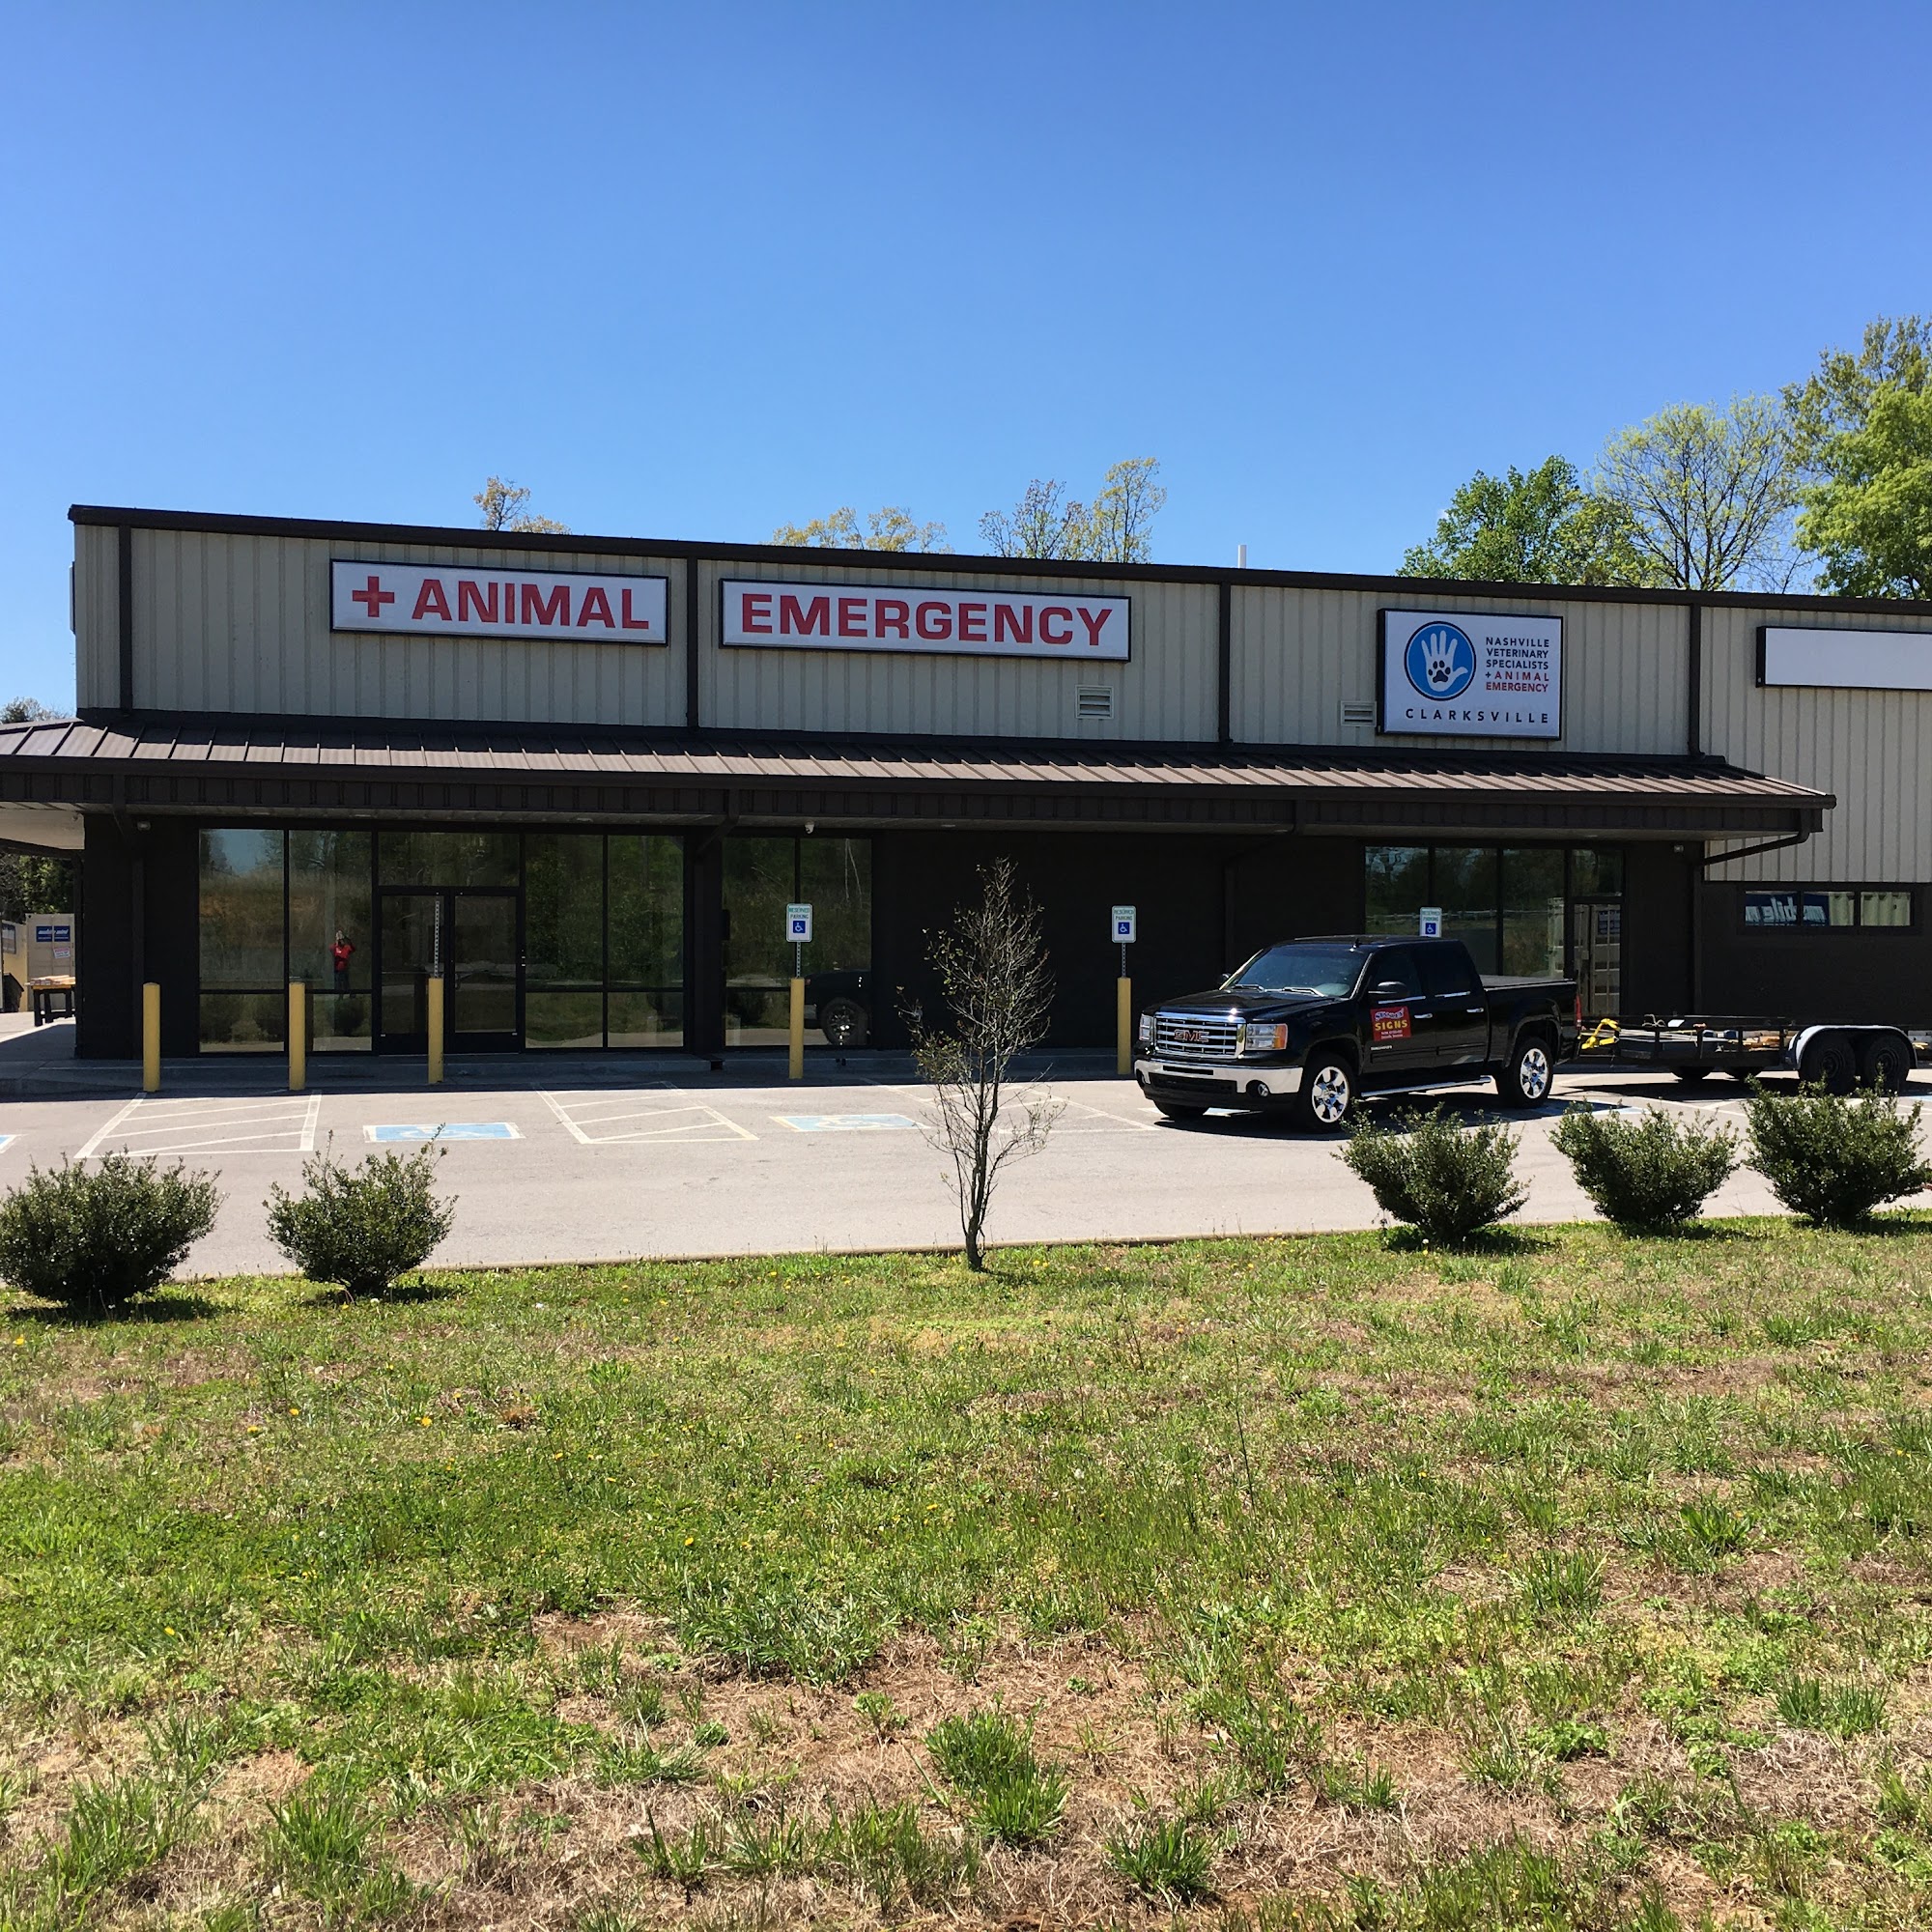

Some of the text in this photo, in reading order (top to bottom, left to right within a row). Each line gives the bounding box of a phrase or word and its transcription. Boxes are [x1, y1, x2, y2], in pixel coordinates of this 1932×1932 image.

[412, 579, 649, 630] ANIMAL
[742, 593, 1113, 646] EMERGENCY
[1486, 637, 1549, 648] NASHVILLE
[1486, 647, 1548, 659] VETERINARY
[1486, 659, 1548, 670] SPECIALISTS
[1486, 681, 1548, 693] EMERGENCY
[1406, 708, 1548, 724] CLARKSVILLE
[1375, 1019, 1408, 1031] SIGNS
[1174, 1028, 1209, 1042] GMC
